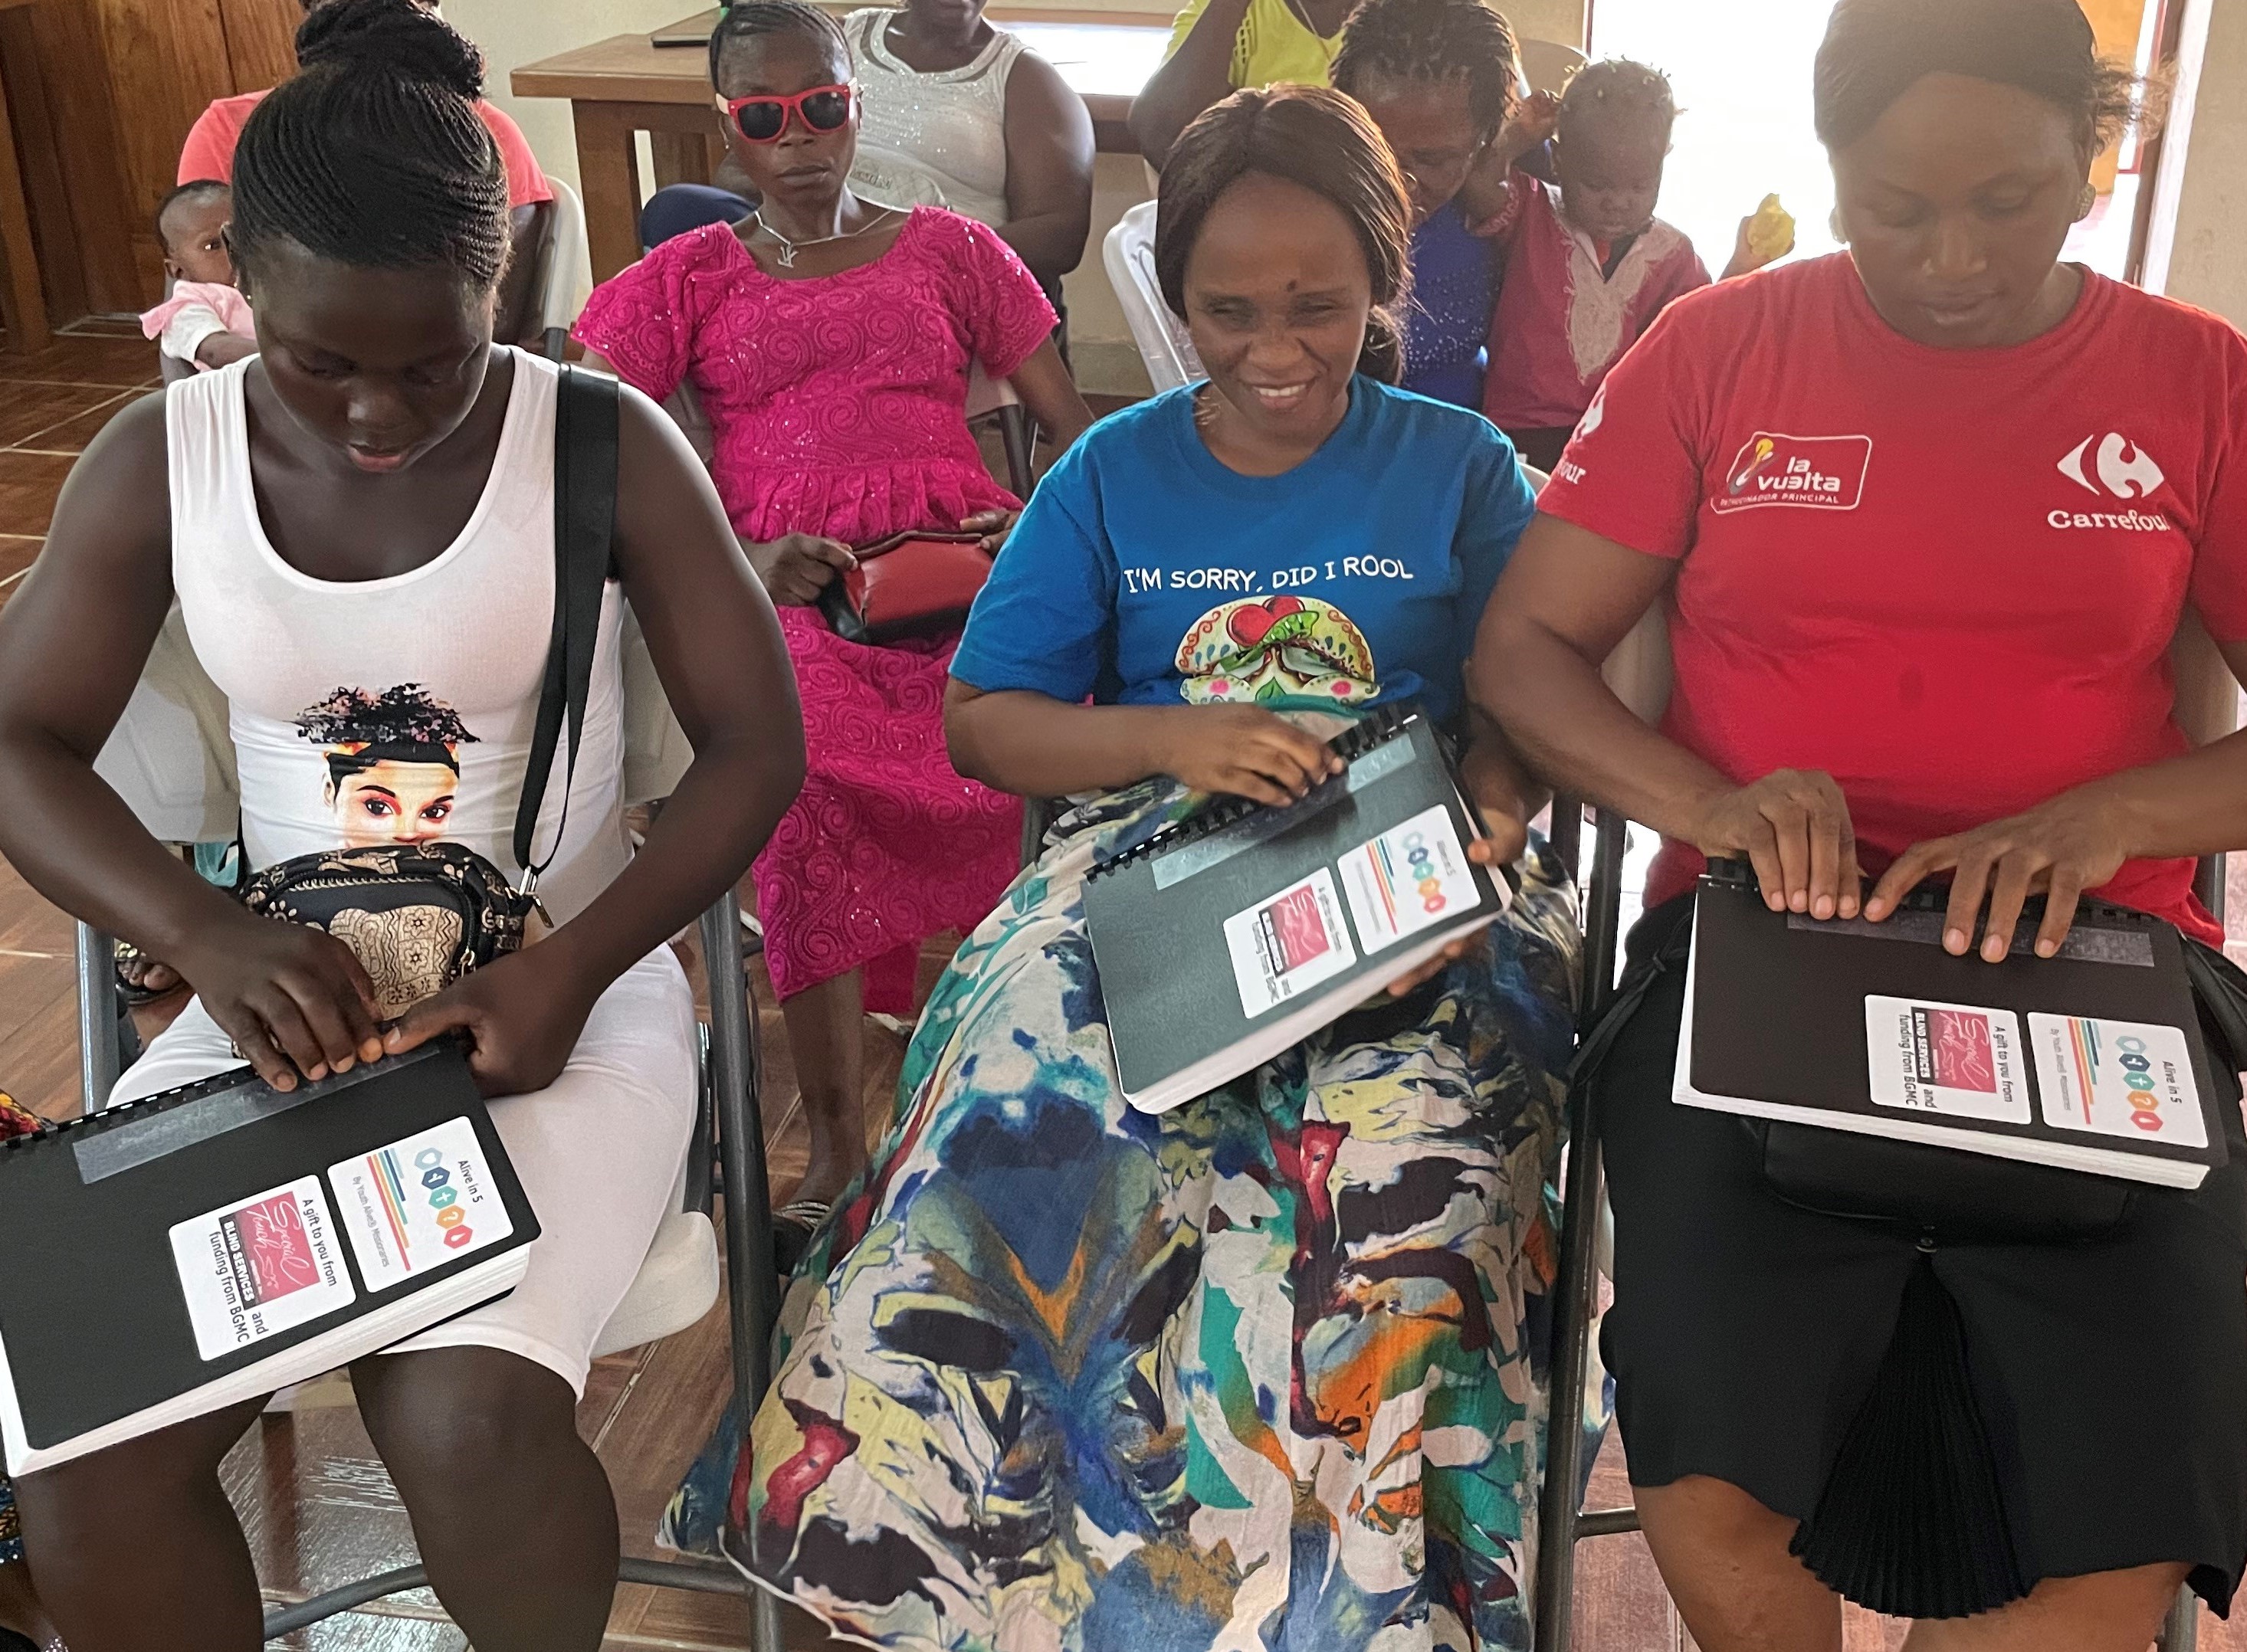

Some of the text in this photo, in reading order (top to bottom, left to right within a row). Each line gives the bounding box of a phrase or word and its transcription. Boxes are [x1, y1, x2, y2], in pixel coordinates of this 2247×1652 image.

[1786, 456, 1811, 474] la
[1782, 493, 1839, 504] PRINCIPAL
[1124, 554, 1414, 594] I'M SORRY, DID I ROOL
[1993, 1034, 2009, 1051] gift
[1898, 1014, 1918, 1106] funding from BGMC
[1997, 1051, 2009, 1060] to
[1996, 1062, 2010, 1079] you
[2162, 1060, 2176, 1083] Alive
[1924, 1089, 1937, 1109] and
[2002, 1080, 2014, 1103] from
[2168, 1085, 2180, 1095] in
[353, 1175, 362, 1185] By
[458, 1160, 484, 1203] Alive in 5
[246, 1203, 282, 1250] Touch
[303, 1207, 320, 1228] gift
[274, 1201, 310, 1286] Special
[312, 1227, 322, 1239] to
[224, 1221, 254, 1302] BLIND SERVICES
[313, 1241, 329, 1260] you
[323, 1261, 337, 1287] from
[209, 1231, 250, 1342] funding from BGMC
[252, 1311, 269, 1335] and
